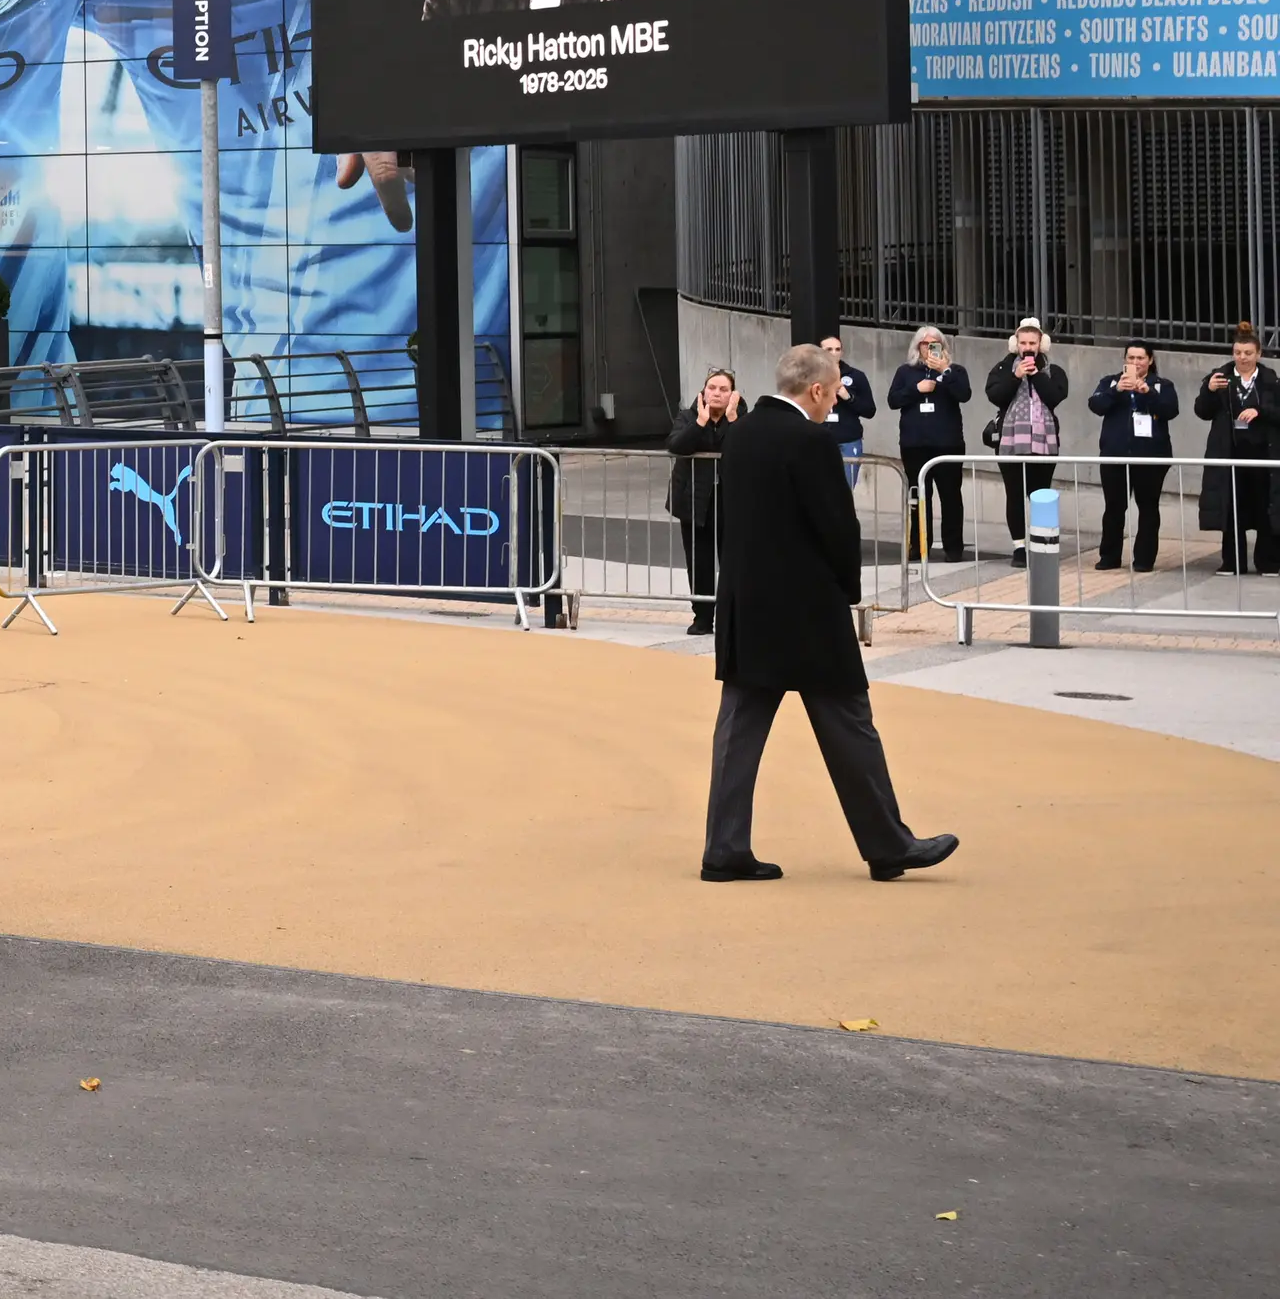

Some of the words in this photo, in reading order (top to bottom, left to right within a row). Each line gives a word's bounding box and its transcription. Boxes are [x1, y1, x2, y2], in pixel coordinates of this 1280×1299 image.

[463, 36, 523, 71] Ricky
[527, 31, 606, 63] Hatton
[610, 19, 670, 56] MBE
[910, 21, 982, 48] MORAVIAN
[984, 19, 1057, 46] CITYZENS
[1079, 17, 1137, 44] SOUTH
[1141, 15, 1209, 43] STAFFS
[519, 67, 609, 95] 1978-2025
[925, 54, 984, 81] TRIPURA
[988, 53, 1061, 80] CITYZENS
[1089, 52, 1141, 79] TUNIS
[321, 500, 501, 537] ETIHAD
